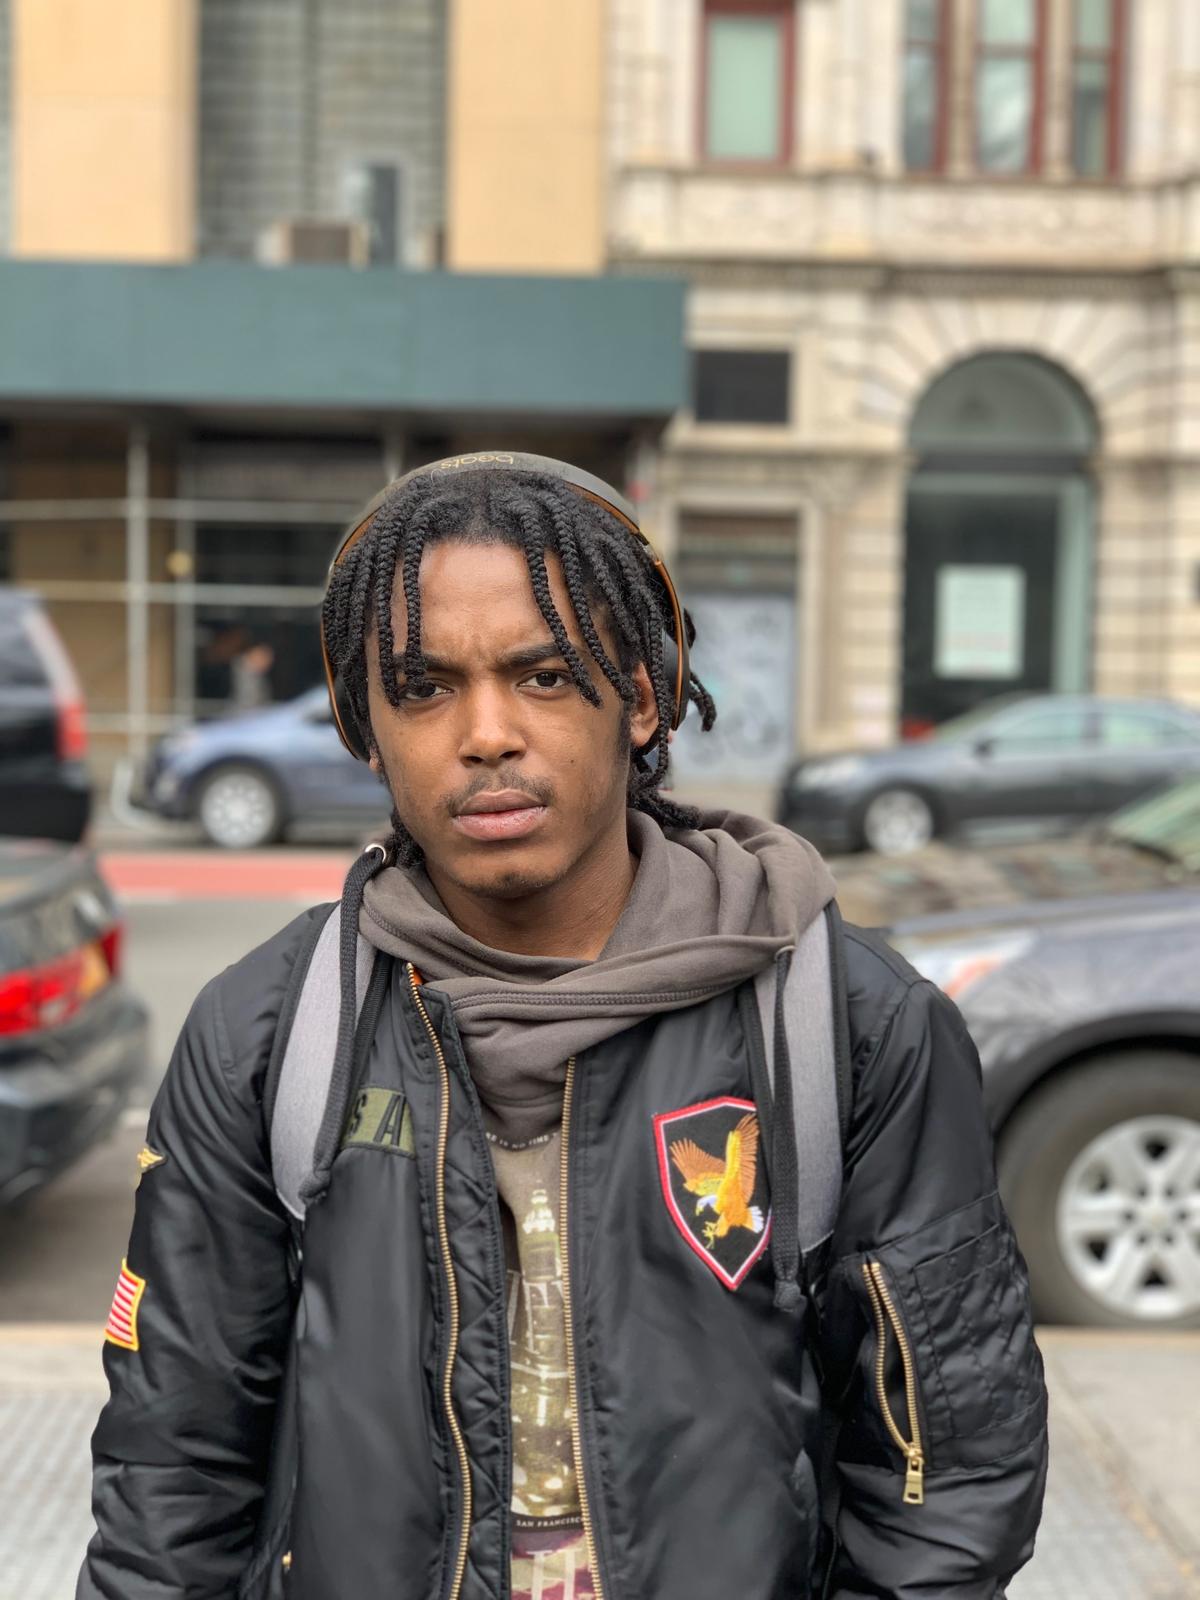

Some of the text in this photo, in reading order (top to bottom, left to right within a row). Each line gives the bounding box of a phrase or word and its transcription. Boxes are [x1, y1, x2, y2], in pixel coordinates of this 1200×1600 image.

[440, 454, 514, 470] beats
[516, 1516, 582, 1528] SAN FRANCISC
